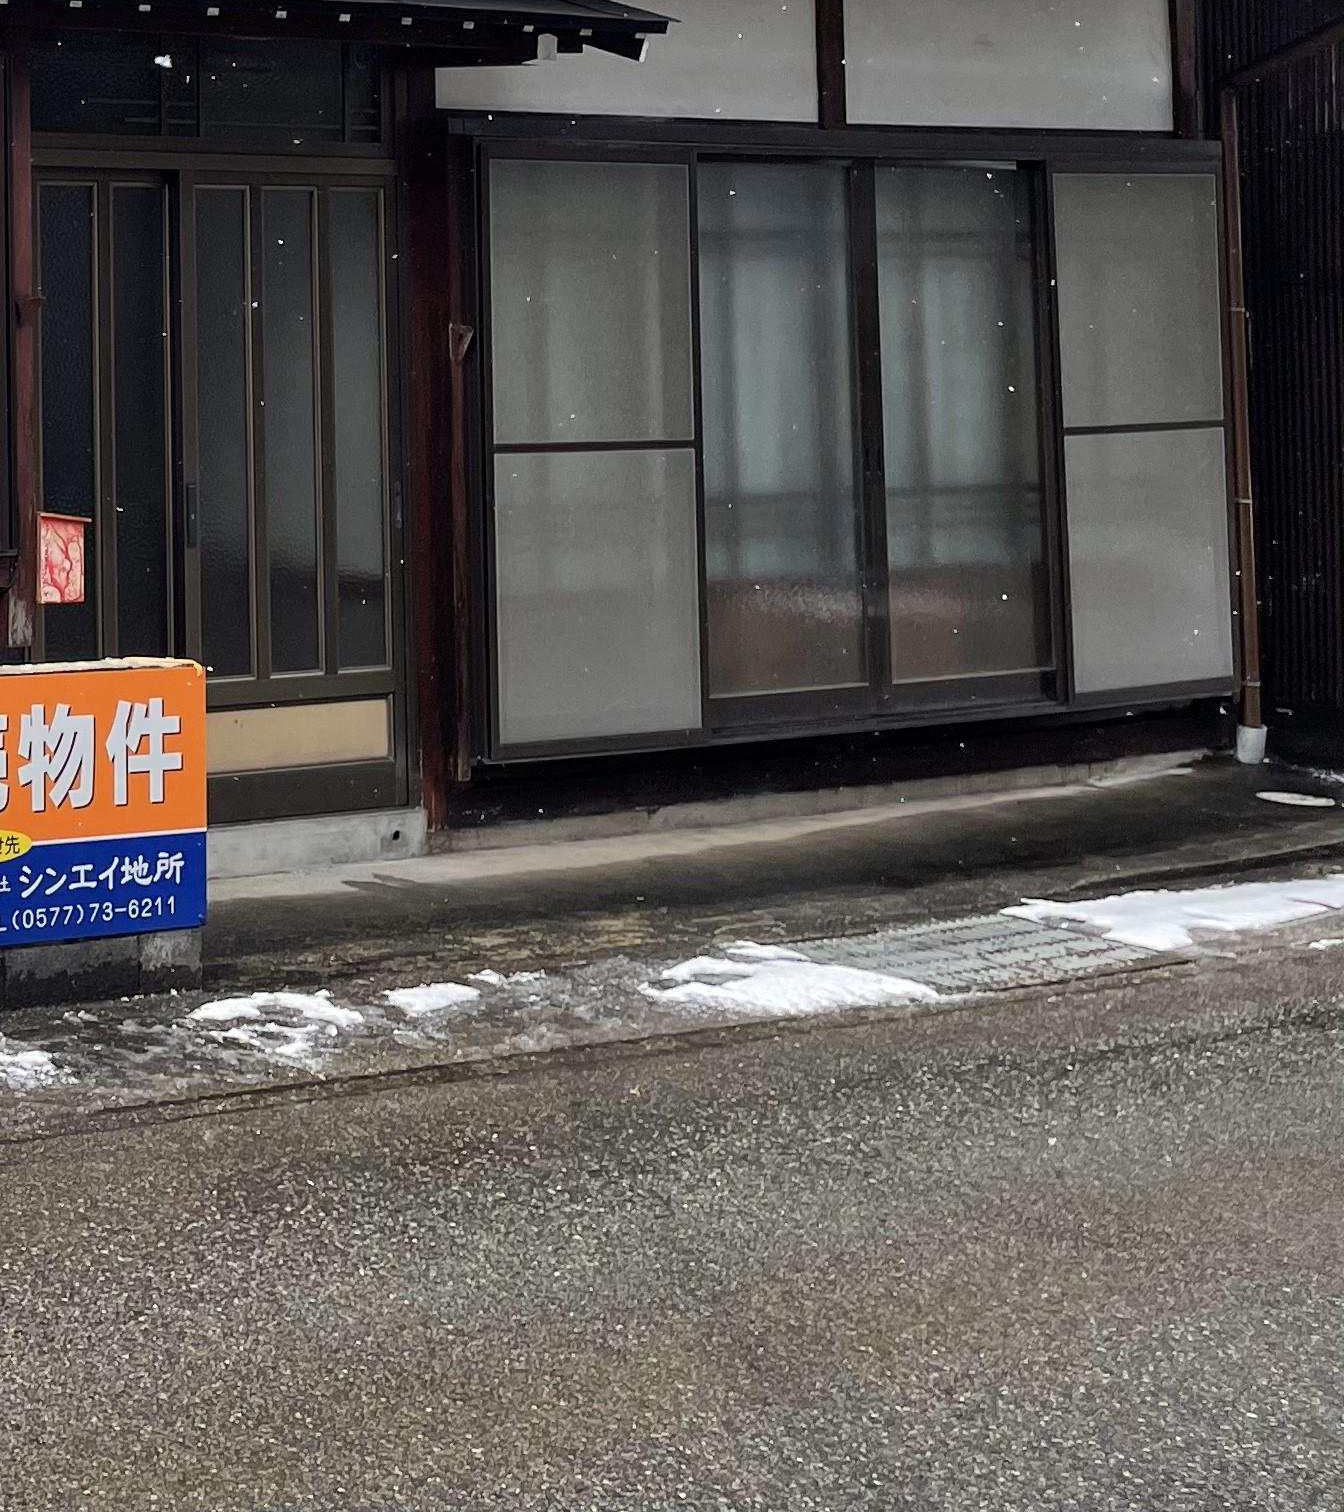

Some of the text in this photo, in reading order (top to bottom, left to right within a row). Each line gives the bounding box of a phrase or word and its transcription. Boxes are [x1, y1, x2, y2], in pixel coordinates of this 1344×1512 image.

[17, 851, 185, 899] シンエイ地所
